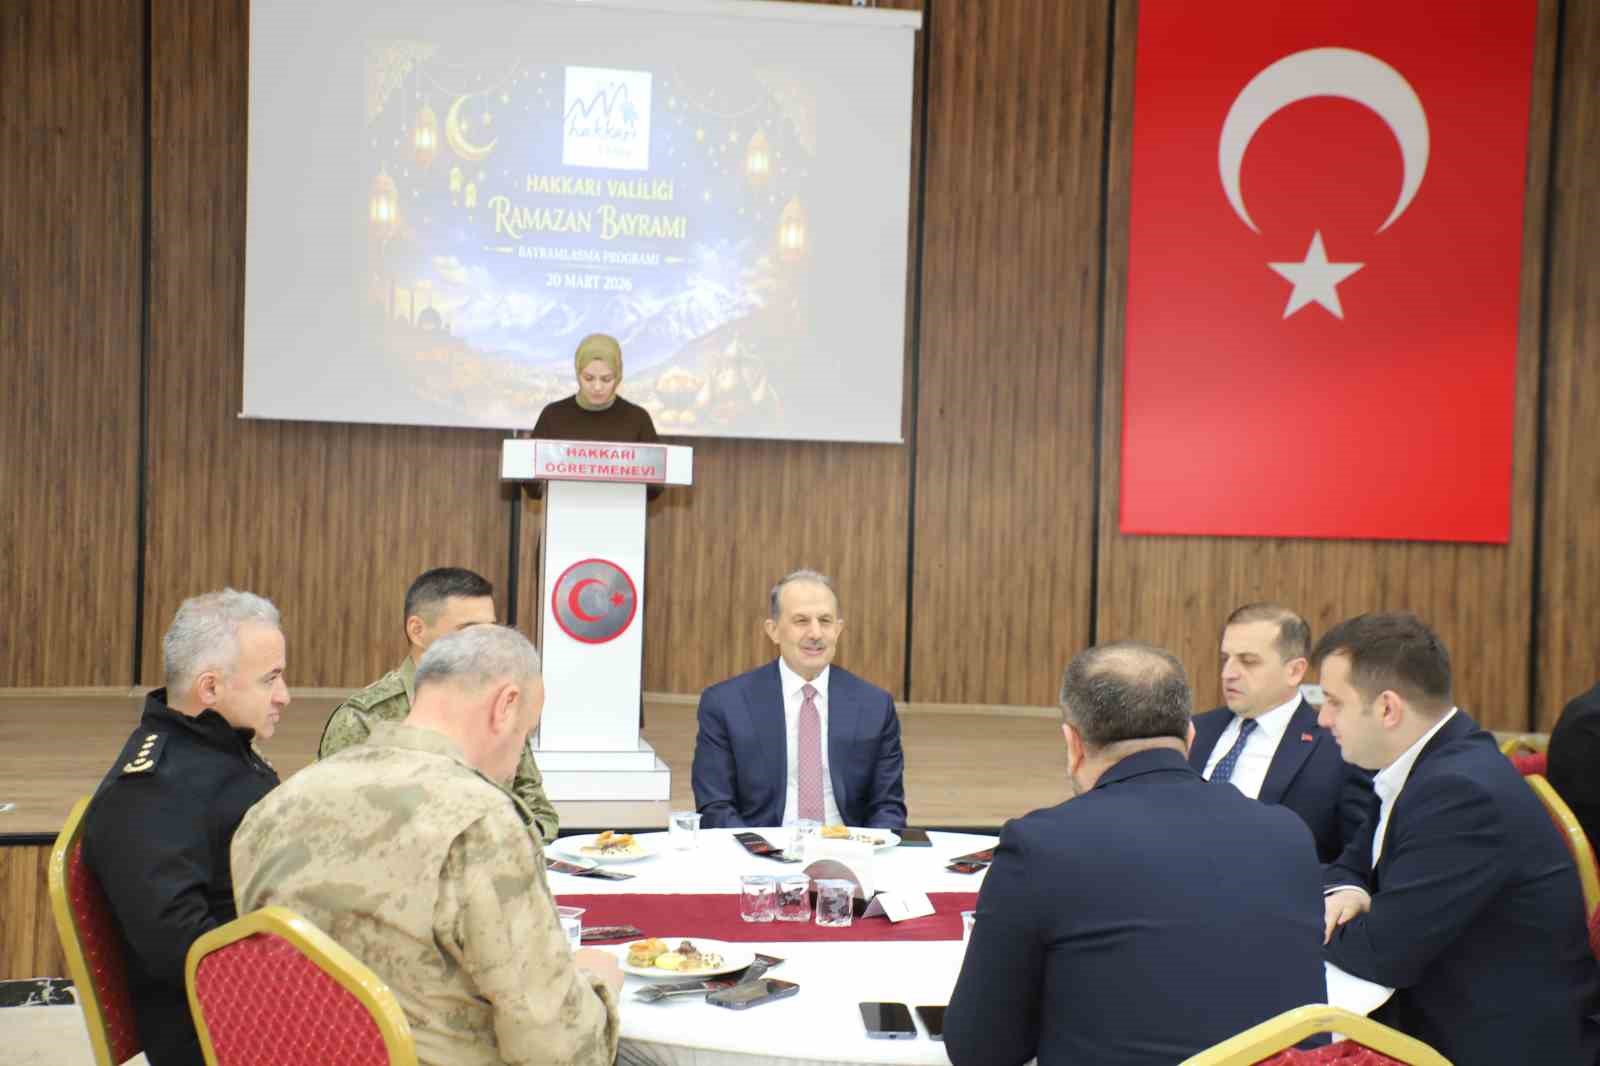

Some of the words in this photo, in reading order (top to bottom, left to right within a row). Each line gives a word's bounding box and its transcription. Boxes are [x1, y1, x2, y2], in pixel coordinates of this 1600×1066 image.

[544, 272, 561, 289] 20
[564, 273, 600, 290] MART
[603, 275, 633, 292] 2026
